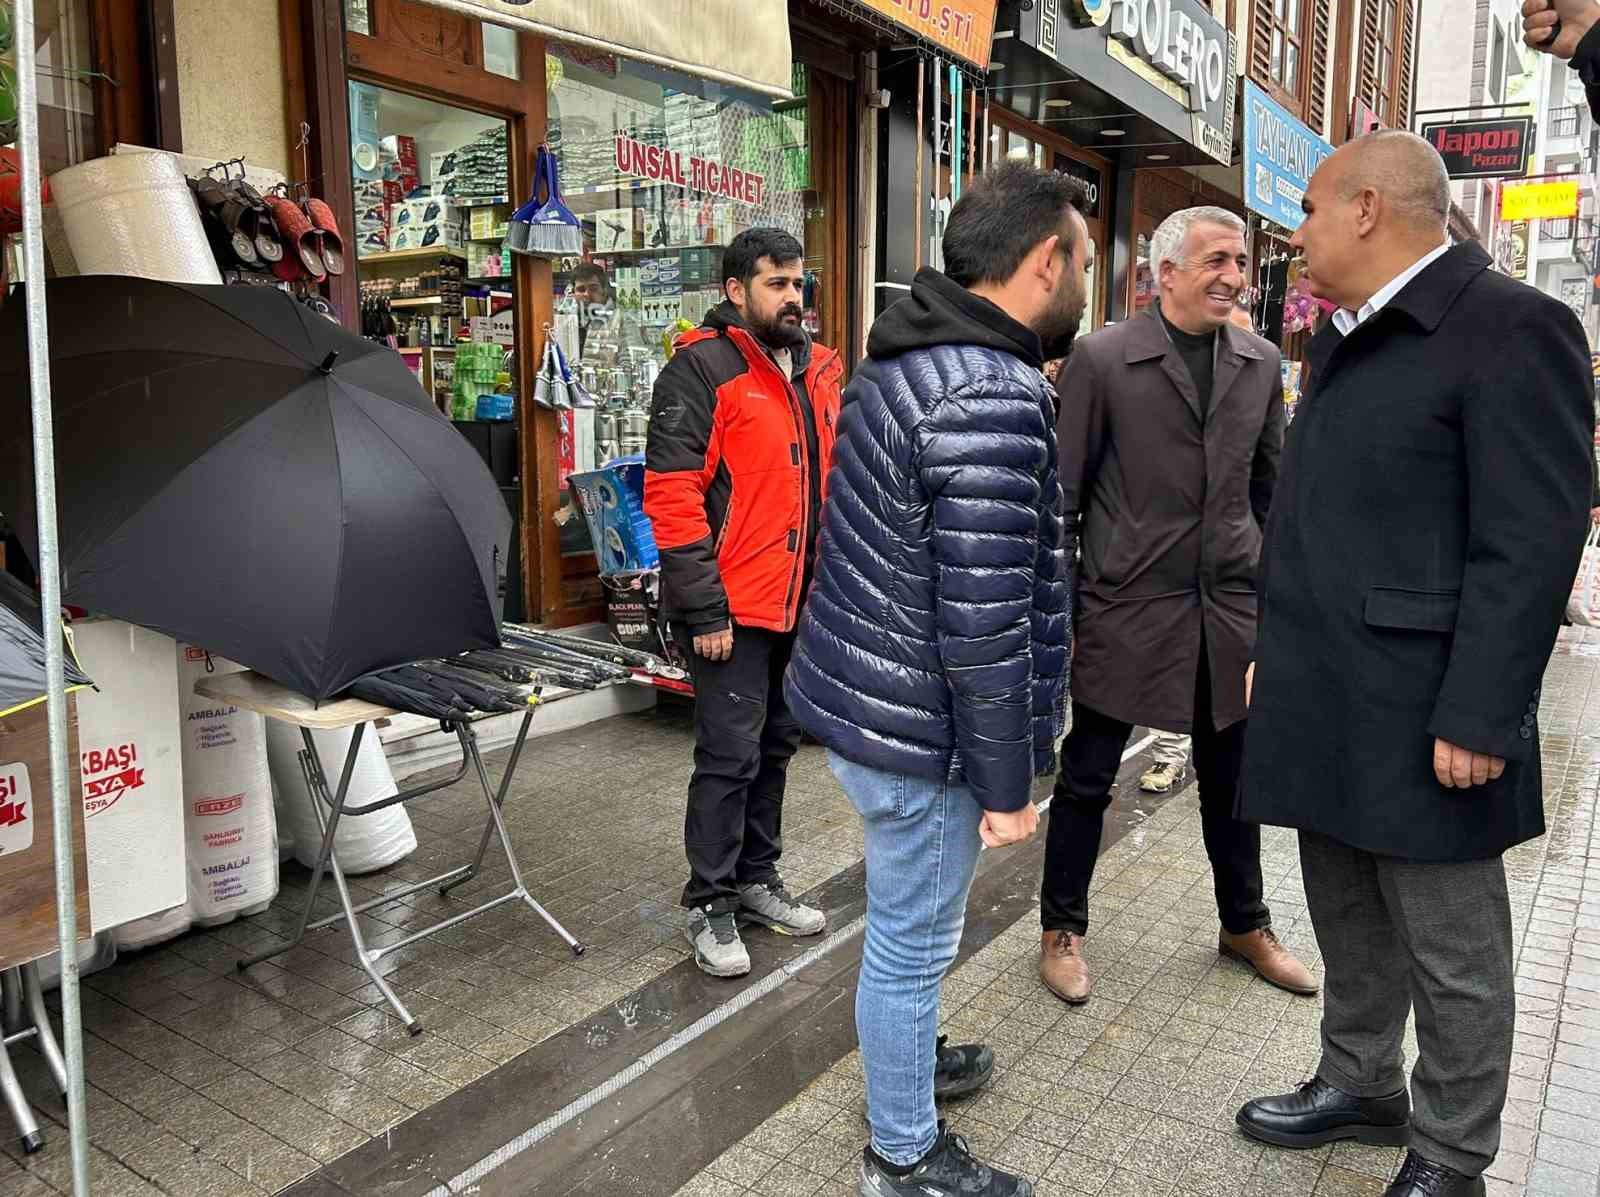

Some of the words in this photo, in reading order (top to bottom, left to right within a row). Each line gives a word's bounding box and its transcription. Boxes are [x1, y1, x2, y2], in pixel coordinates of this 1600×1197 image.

[895, 0, 973, 43] D.ŞTİ
[1253, 97, 1329, 185] TAYHANLA
[1437, 126, 1520, 157] Japon
[1472, 153, 1519, 167] Pazarı
[616, 129, 687, 188] ÜNSAL
[690, 152, 765, 206] TİCARET
